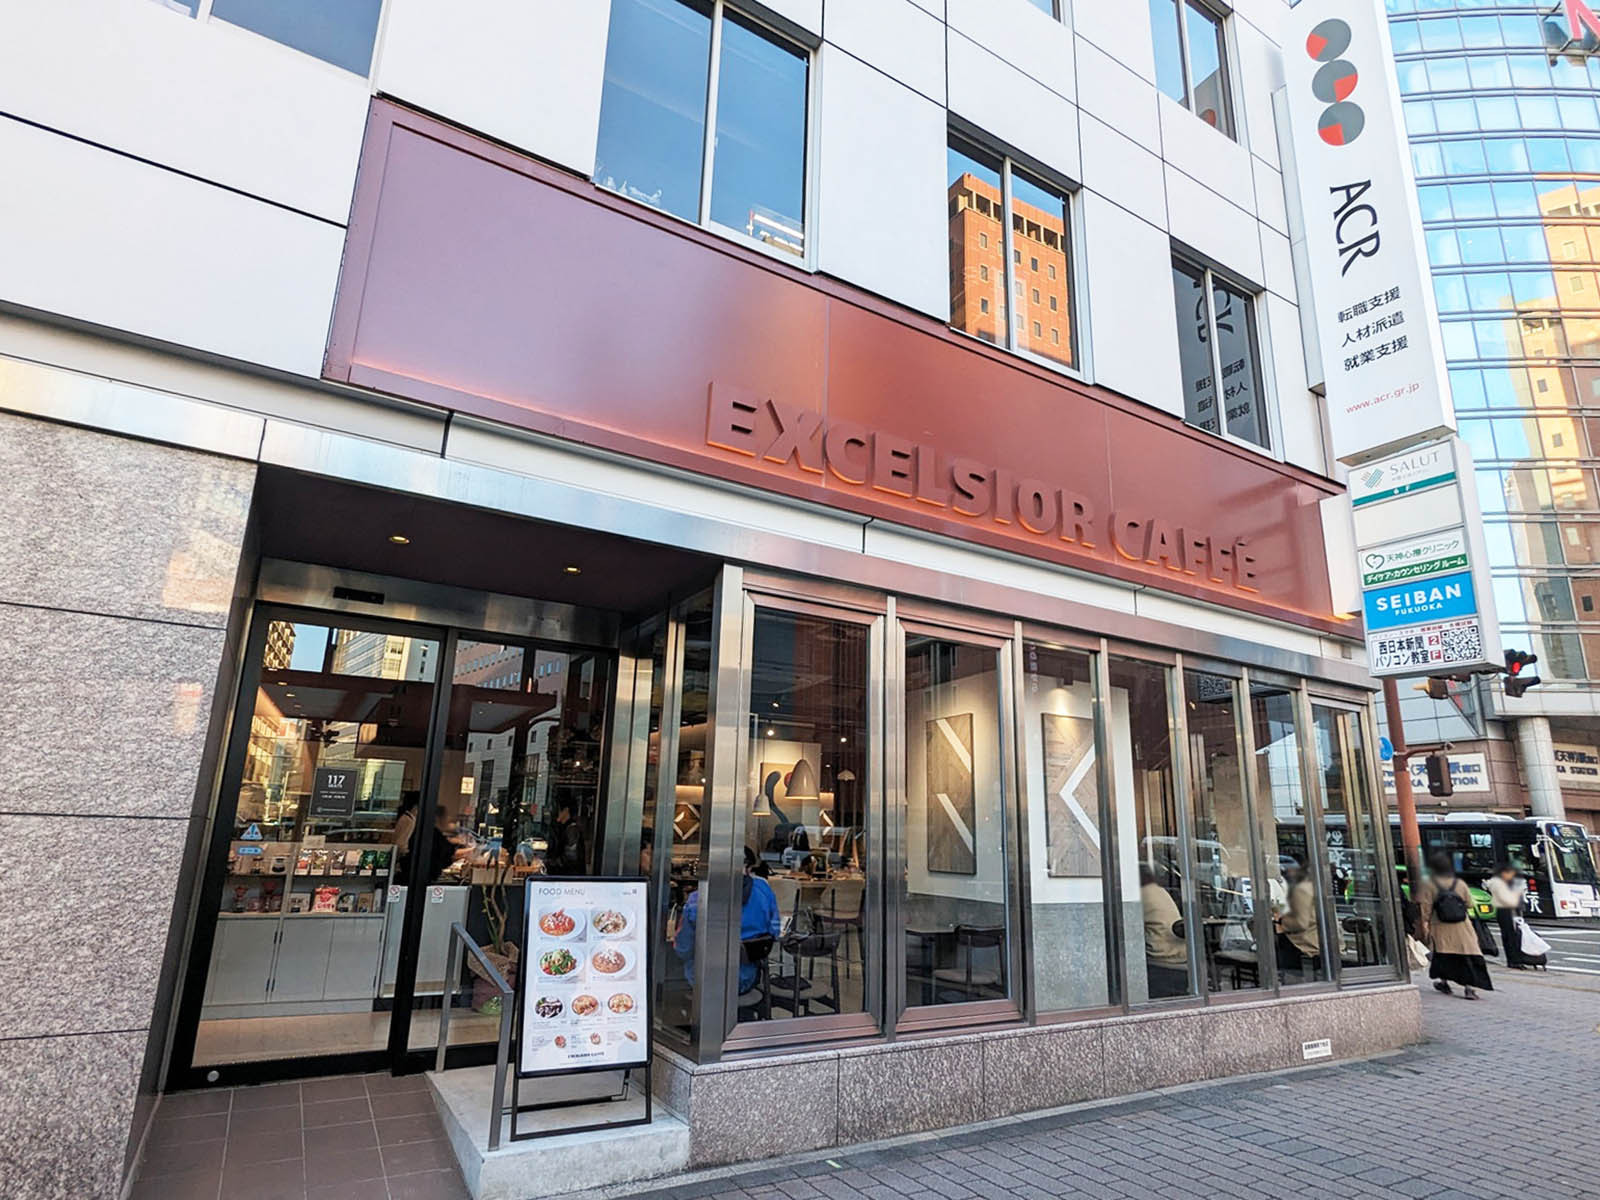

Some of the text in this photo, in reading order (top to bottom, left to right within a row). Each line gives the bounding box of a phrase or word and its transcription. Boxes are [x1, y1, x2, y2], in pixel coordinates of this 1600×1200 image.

[1330, 180, 1381, 278] ACR
[1338, 286, 1401, 323] 転職支援
[1342, 310, 1405, 348] 人材派遣
[1344, 335, 1409, 371] 就業支援
[1346, 382, 1420, 414] www.acr.gr.jp
[706, 381, 1096, 549] EXCELSIOR
[1390, 450, 1440, 475] SALUT
[1376, 583, 1461, 611] SEIBAN
[1395, 602, 1443, 616] FUKUOKA
[1375, 649, 1430, 668] パソコン教室
[1379, 635, 1424, 655] 西日本新聞
[328, 774, 346, 785] 117
[538, 887, 586, 896] FOOD MENU
